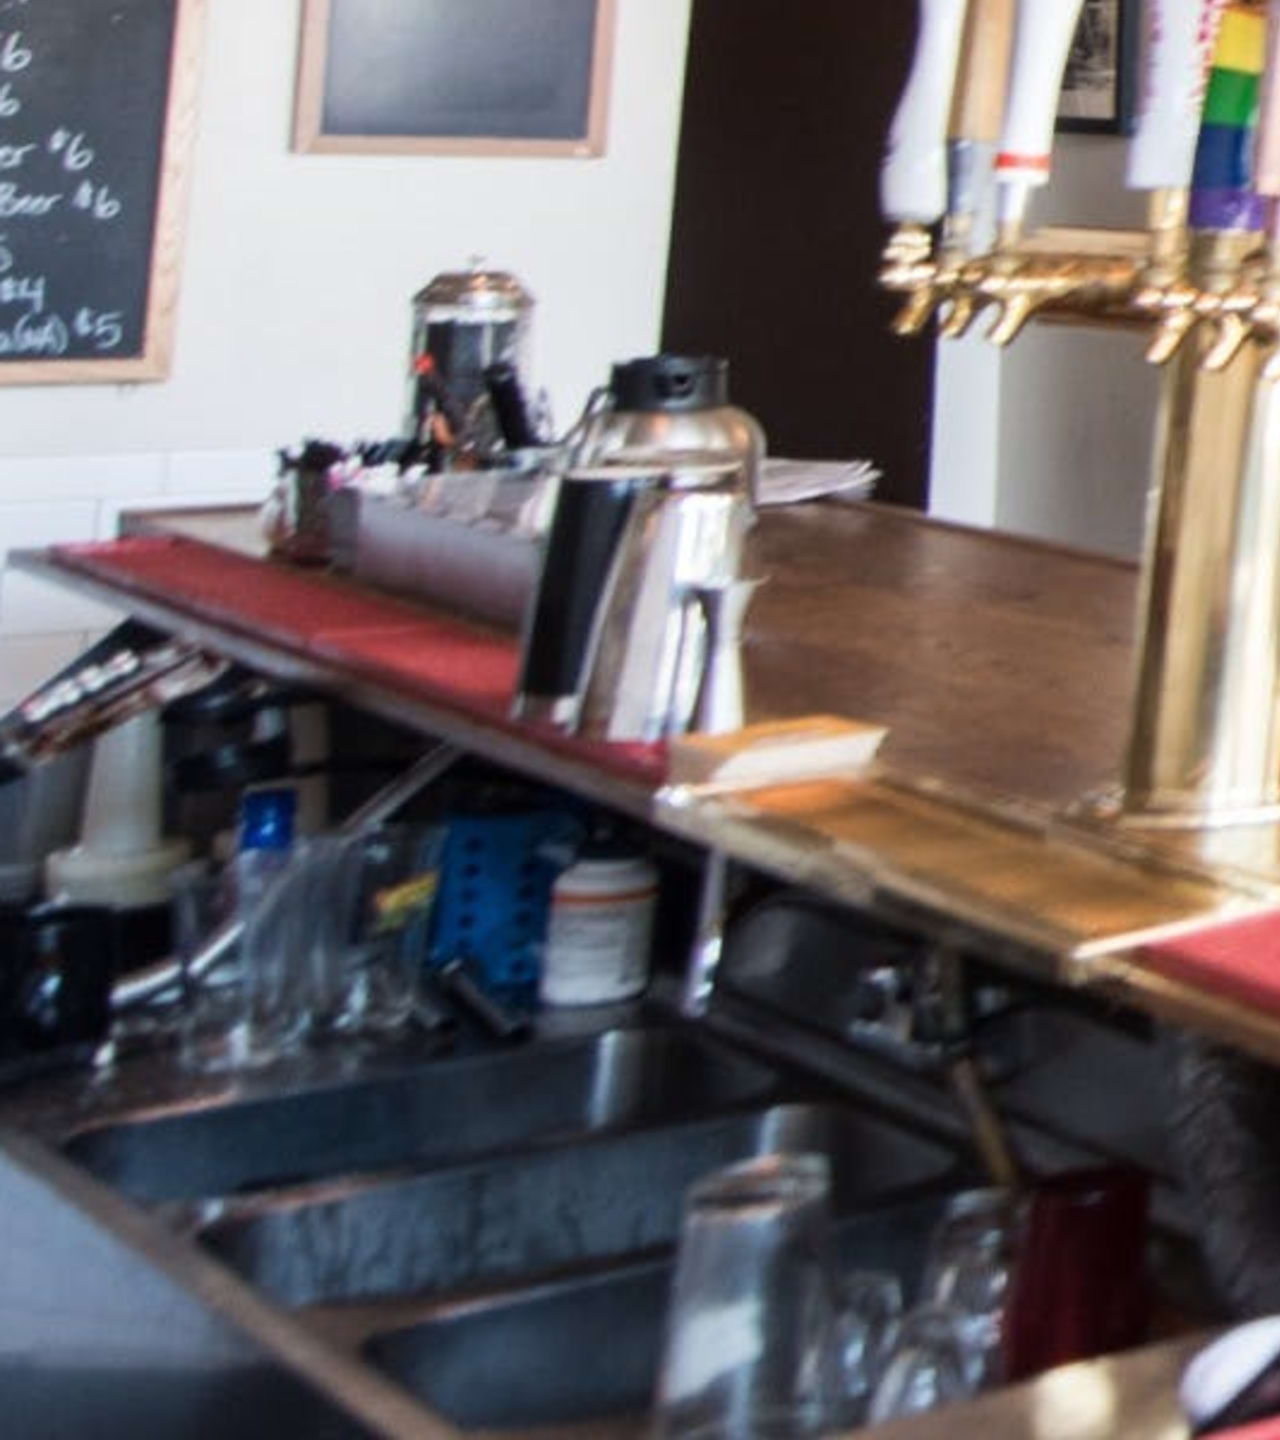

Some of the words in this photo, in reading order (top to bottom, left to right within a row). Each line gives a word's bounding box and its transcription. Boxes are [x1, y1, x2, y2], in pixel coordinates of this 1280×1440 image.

[47, 126, 92, 171] $6
[73, 181, 121, 219] $6
[73, 308, 122, 349] $5
